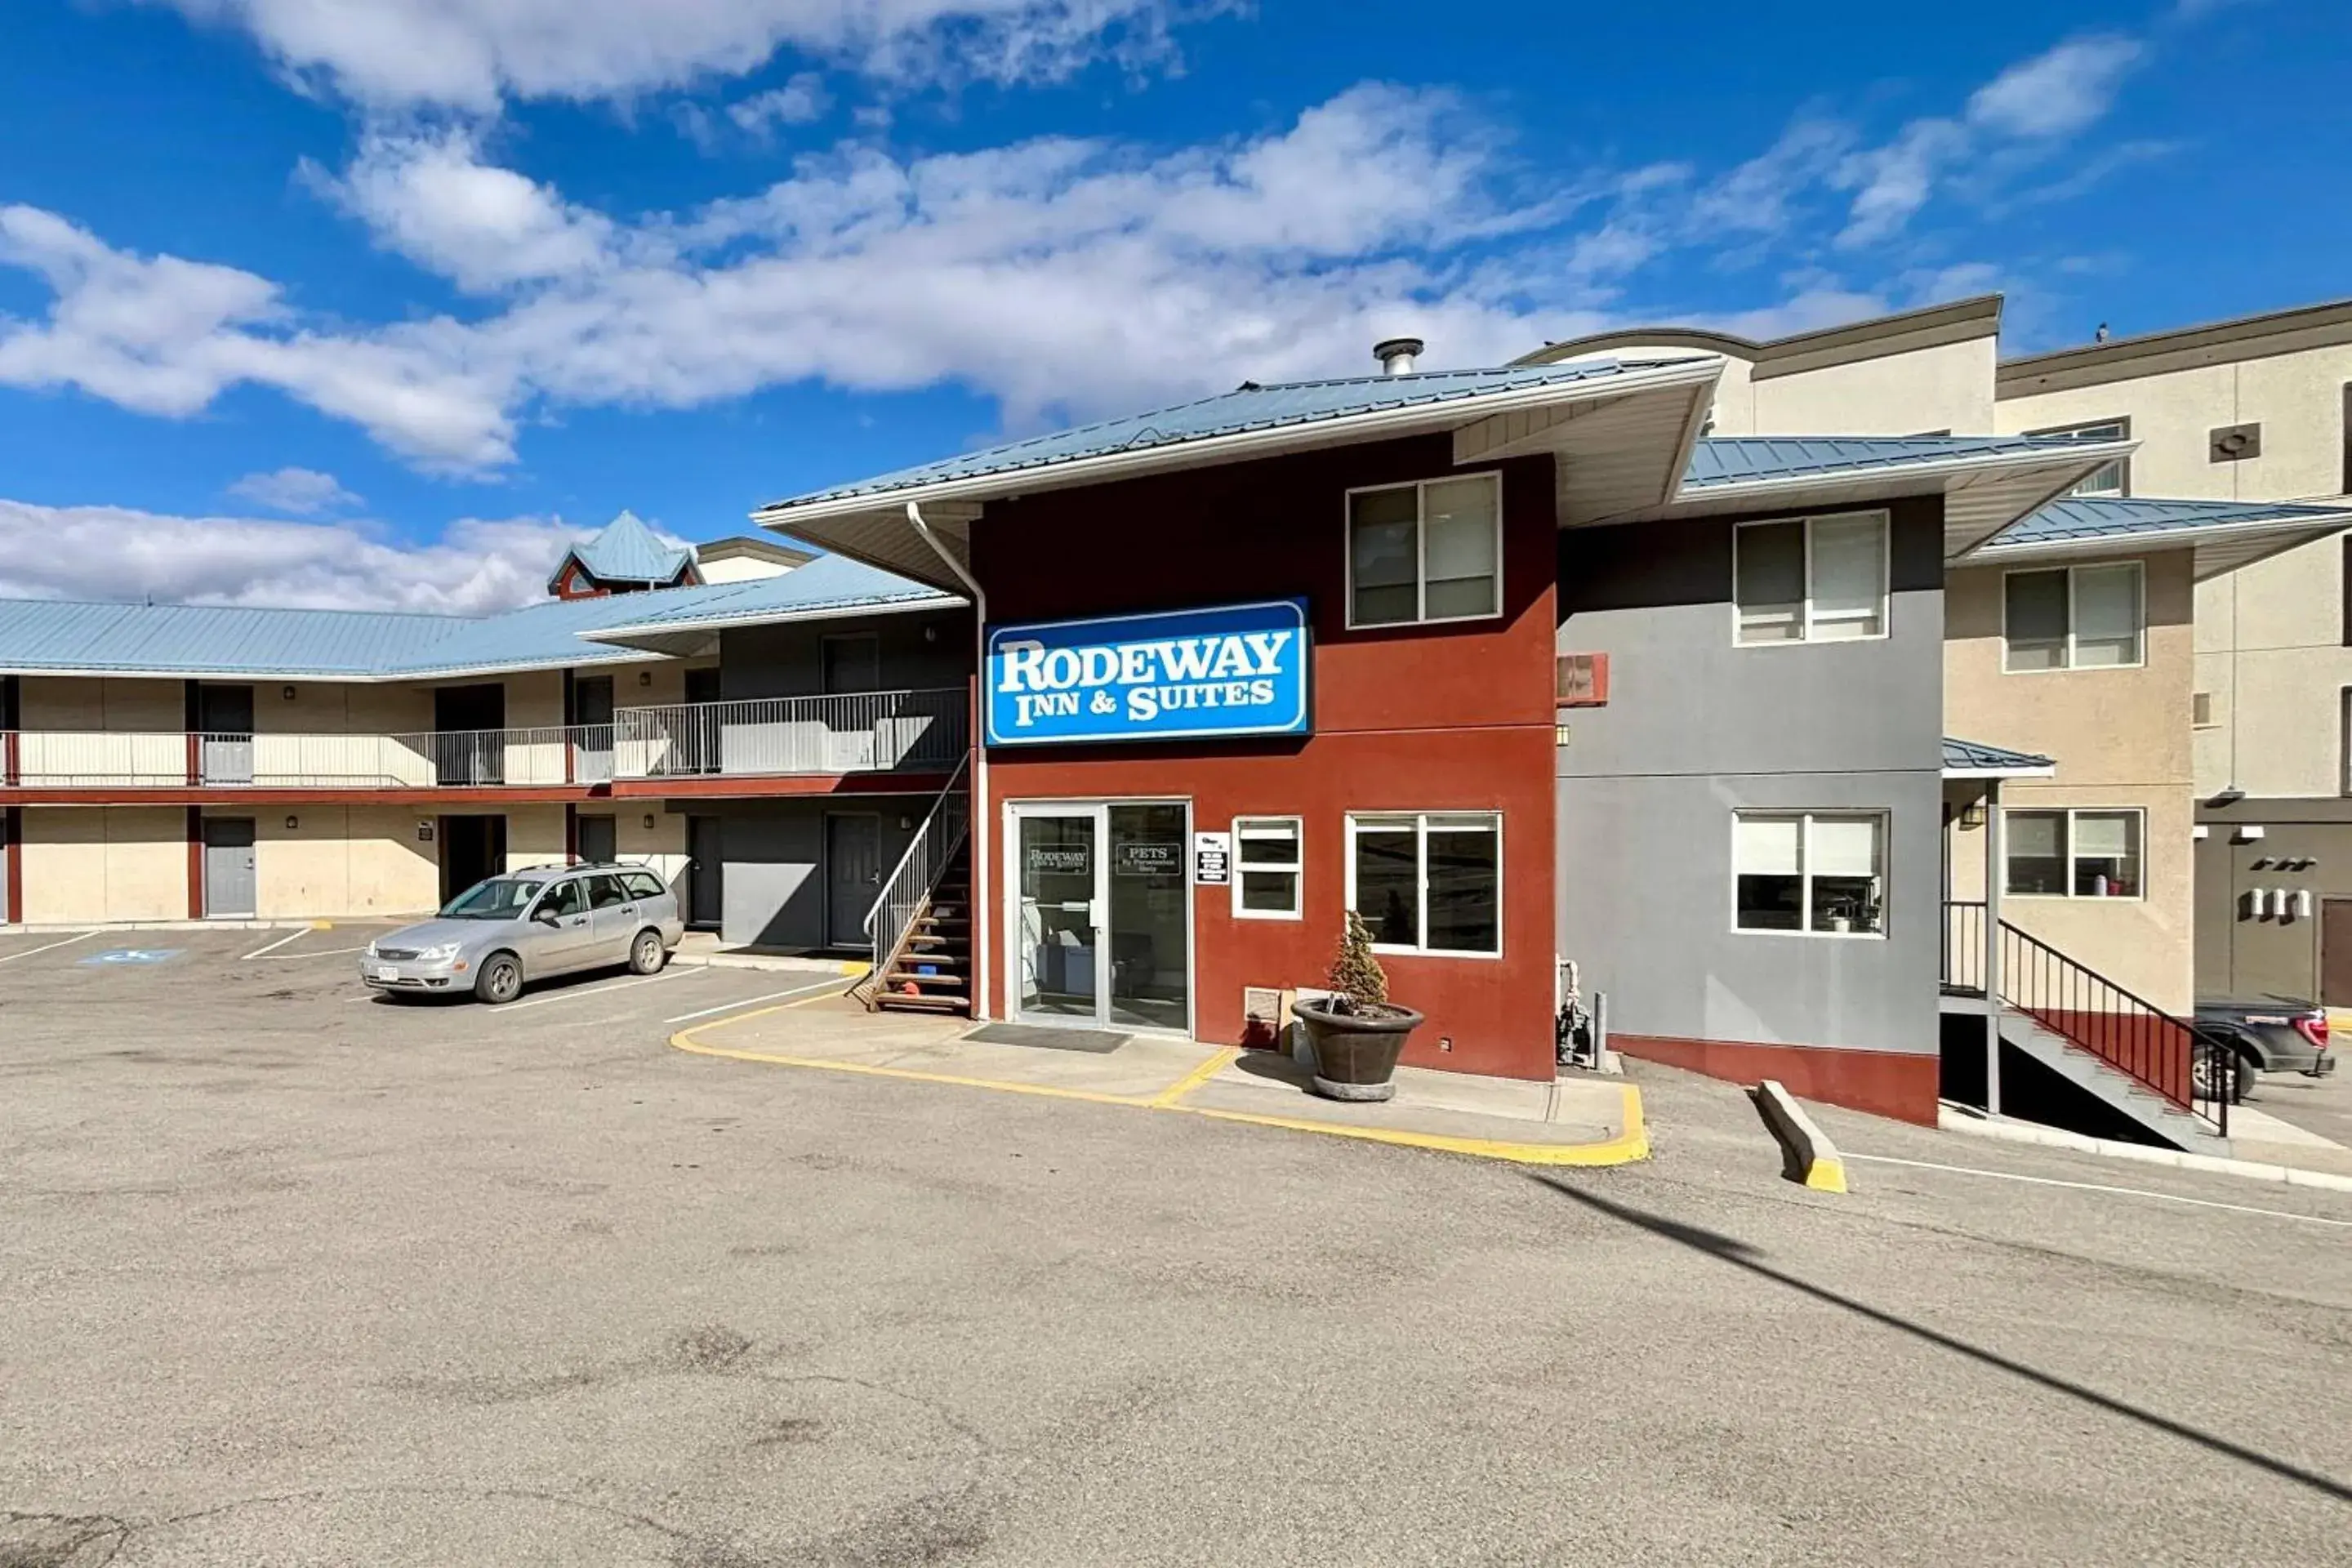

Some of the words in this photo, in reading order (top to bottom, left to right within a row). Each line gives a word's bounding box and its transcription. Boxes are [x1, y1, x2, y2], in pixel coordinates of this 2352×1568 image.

[998, 631, 1291, 693] RODEWAY
[1015, 692, 1080, 727] INN
[1089, 689, 1117, 715] &
[1127, 679, 1274, 722] SUITES
[1031, 849, 1088, 862] RODEWAY
[1129, 848, 1167, 858] PETS
